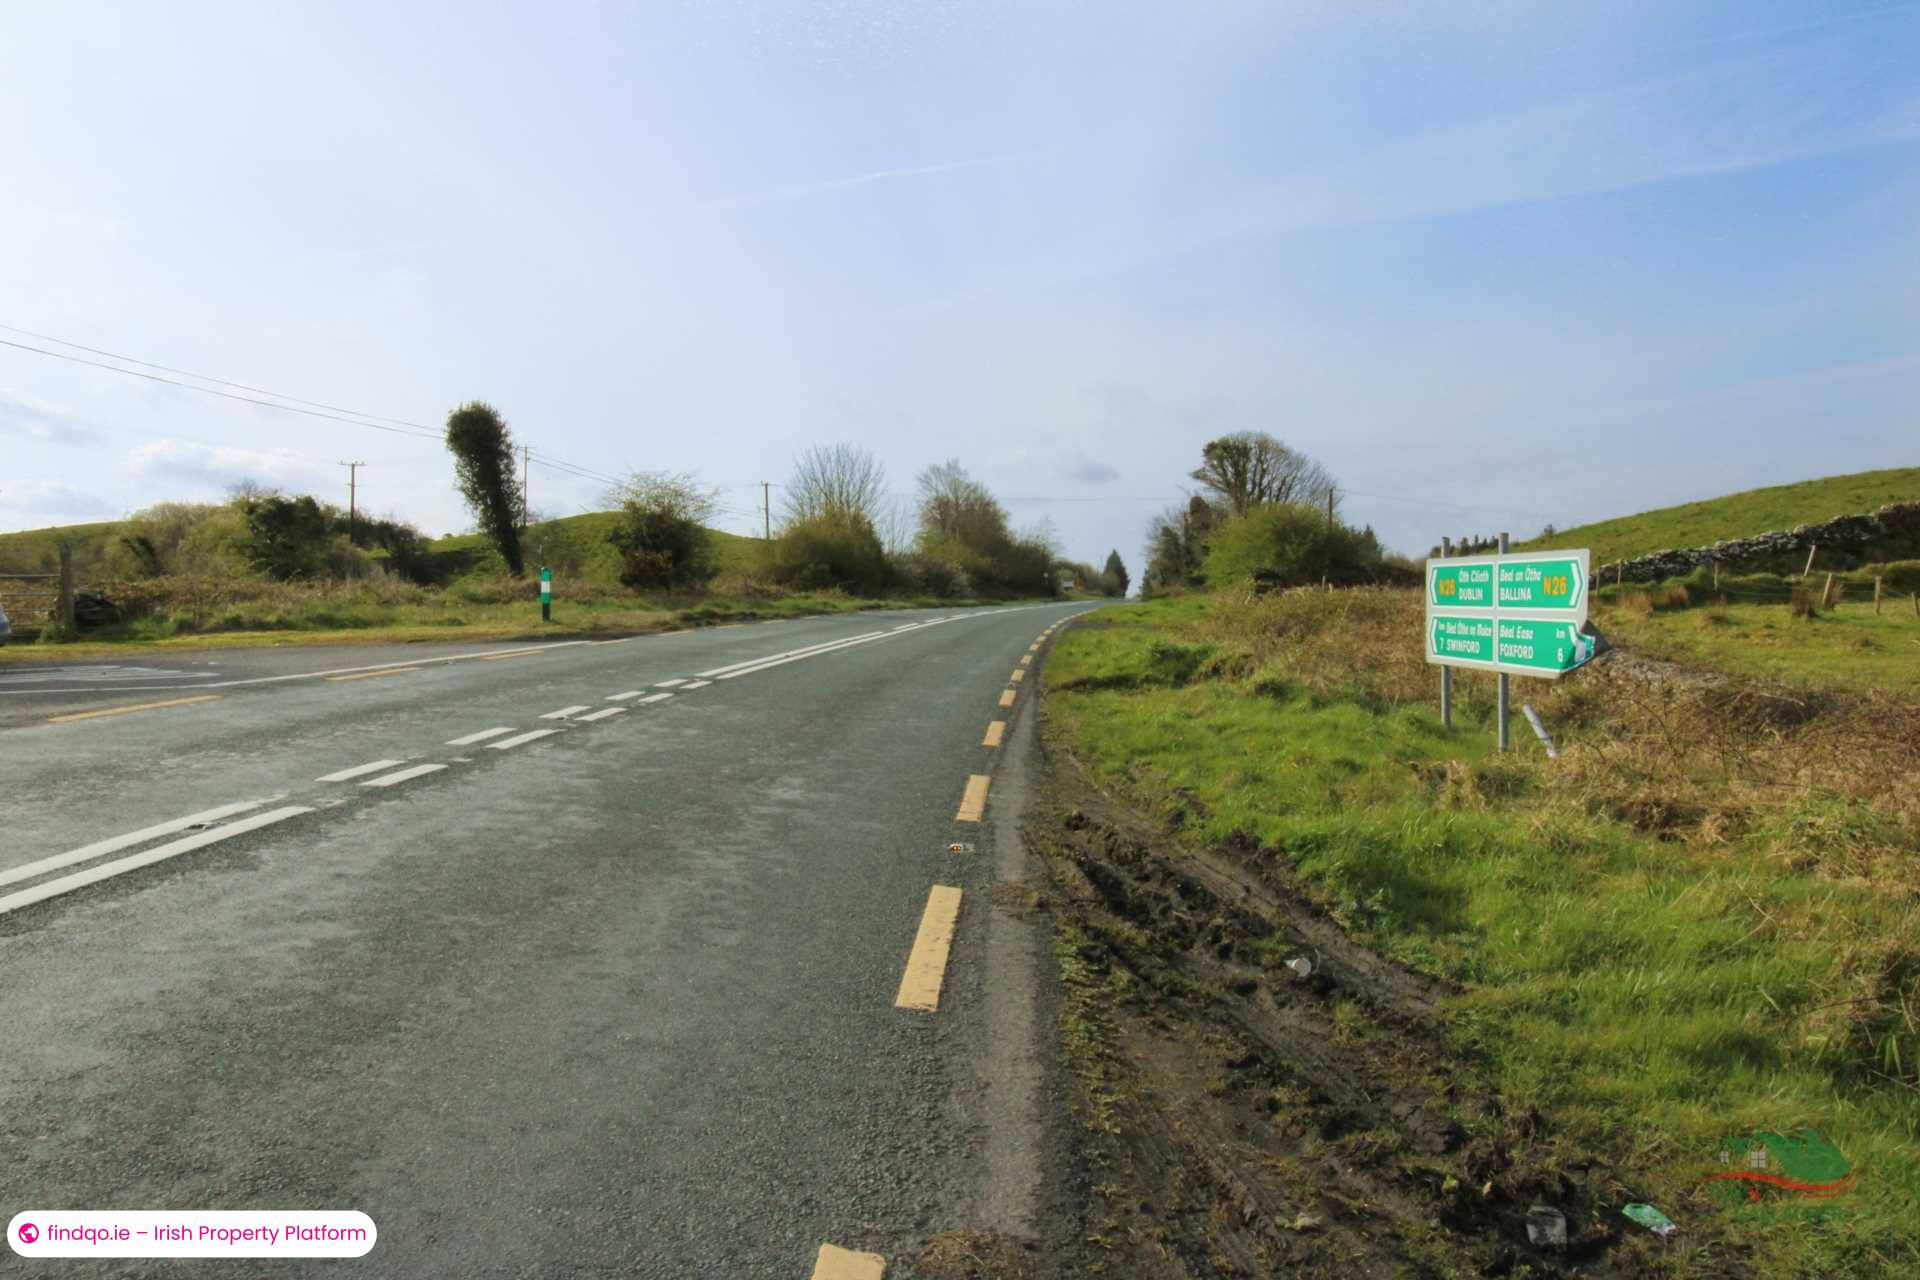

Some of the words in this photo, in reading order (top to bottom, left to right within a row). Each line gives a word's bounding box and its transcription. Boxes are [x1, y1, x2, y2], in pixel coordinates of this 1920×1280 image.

[1543, 576, 1567, 595] N26
[1459, 588, 1484, 601] DUBLIN
[1500, 588, 1532, 601] BALLINA
[1556, 629, 1565, 639] km
[1447, 639, 1480, 654] SWINFORD
[1500, 644, 1534, 659] FOXFORD
[1557, 648, 1564, 663] 6
